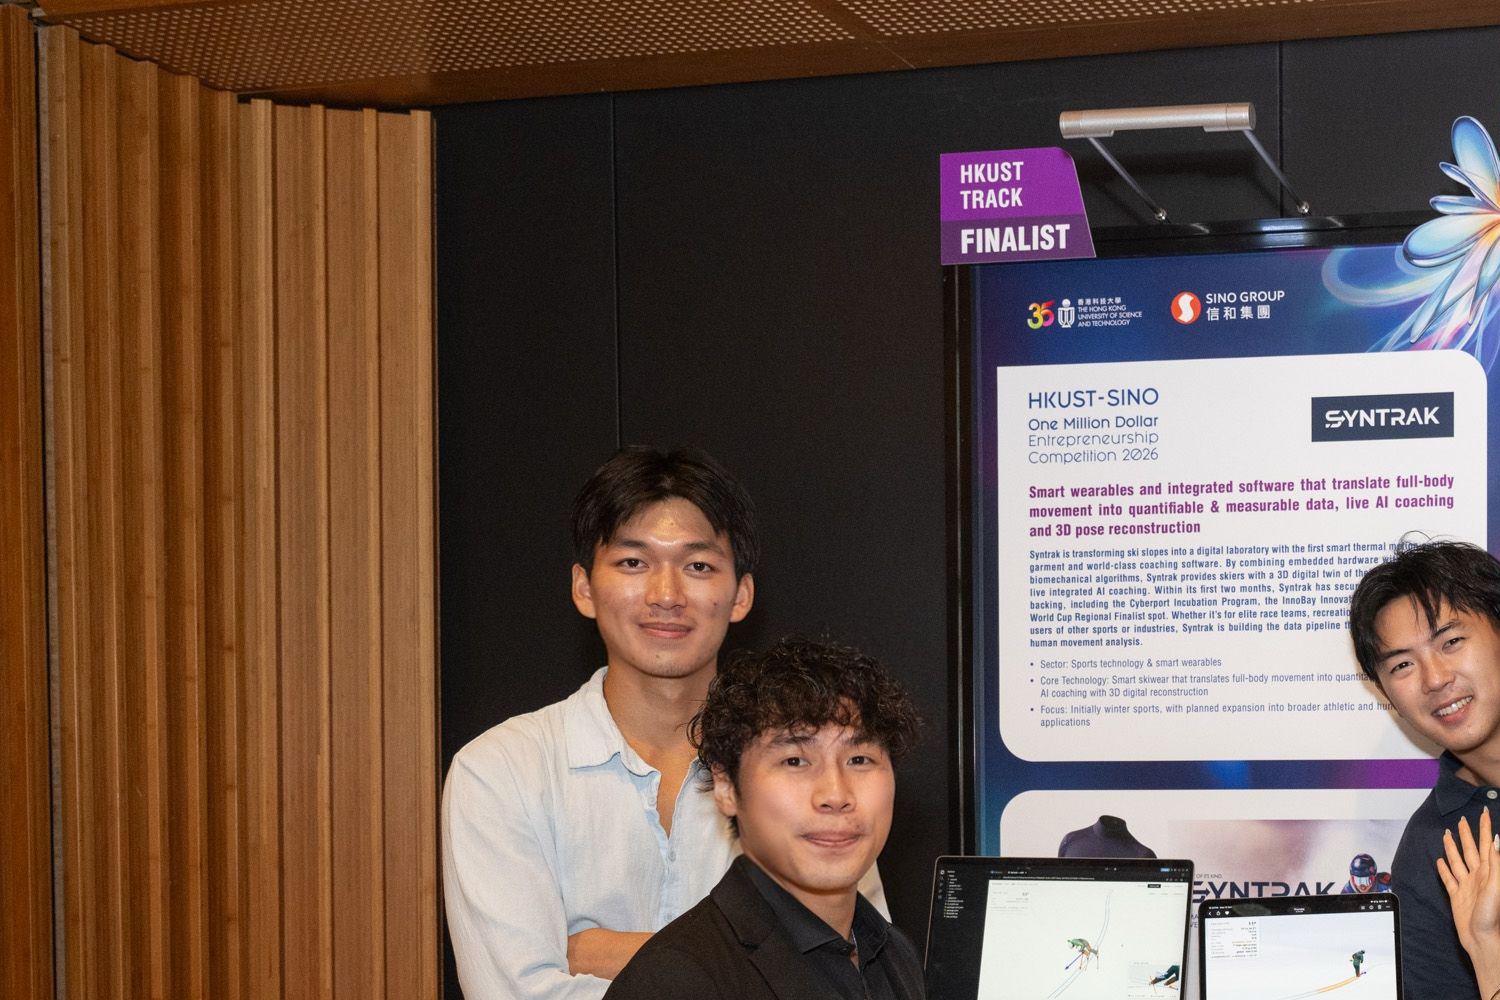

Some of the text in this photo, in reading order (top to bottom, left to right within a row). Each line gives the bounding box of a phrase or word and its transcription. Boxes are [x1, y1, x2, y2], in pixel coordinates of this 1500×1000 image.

[960, 161, 1024, 183] HKUST
[959, 187, 1023, 209] TRACK
[960, 224, 1070, 253] FINALIST
[1205, 290, 1285, 304] SINO GROUP
[1205, 304, 1270, 321] 信和集團
[1028, 388, 1159, 408] HKUST-SINO
[1028, 415, 1158, 431] One Million Dollar
[1325, 406, 1440, 428] SYNTRAK
[1028, 431, 1159, 447] Entrepreneurship
[1028, 447, 1159, 464] Competition 2026
[1029, 474, 1454, 498] Smart wearables and integrated software that translate full-body
[1029, 494, 1454, 518] movement into quantifiable & measurable data, live AI coaching
[1029, 521, 1200, 538] and 3D pose reconstruction
[1030, 637, 1143, 648] human movement analysis.
[1040, 657, 1222, 670] Sector: Sports technology & smart wearables
